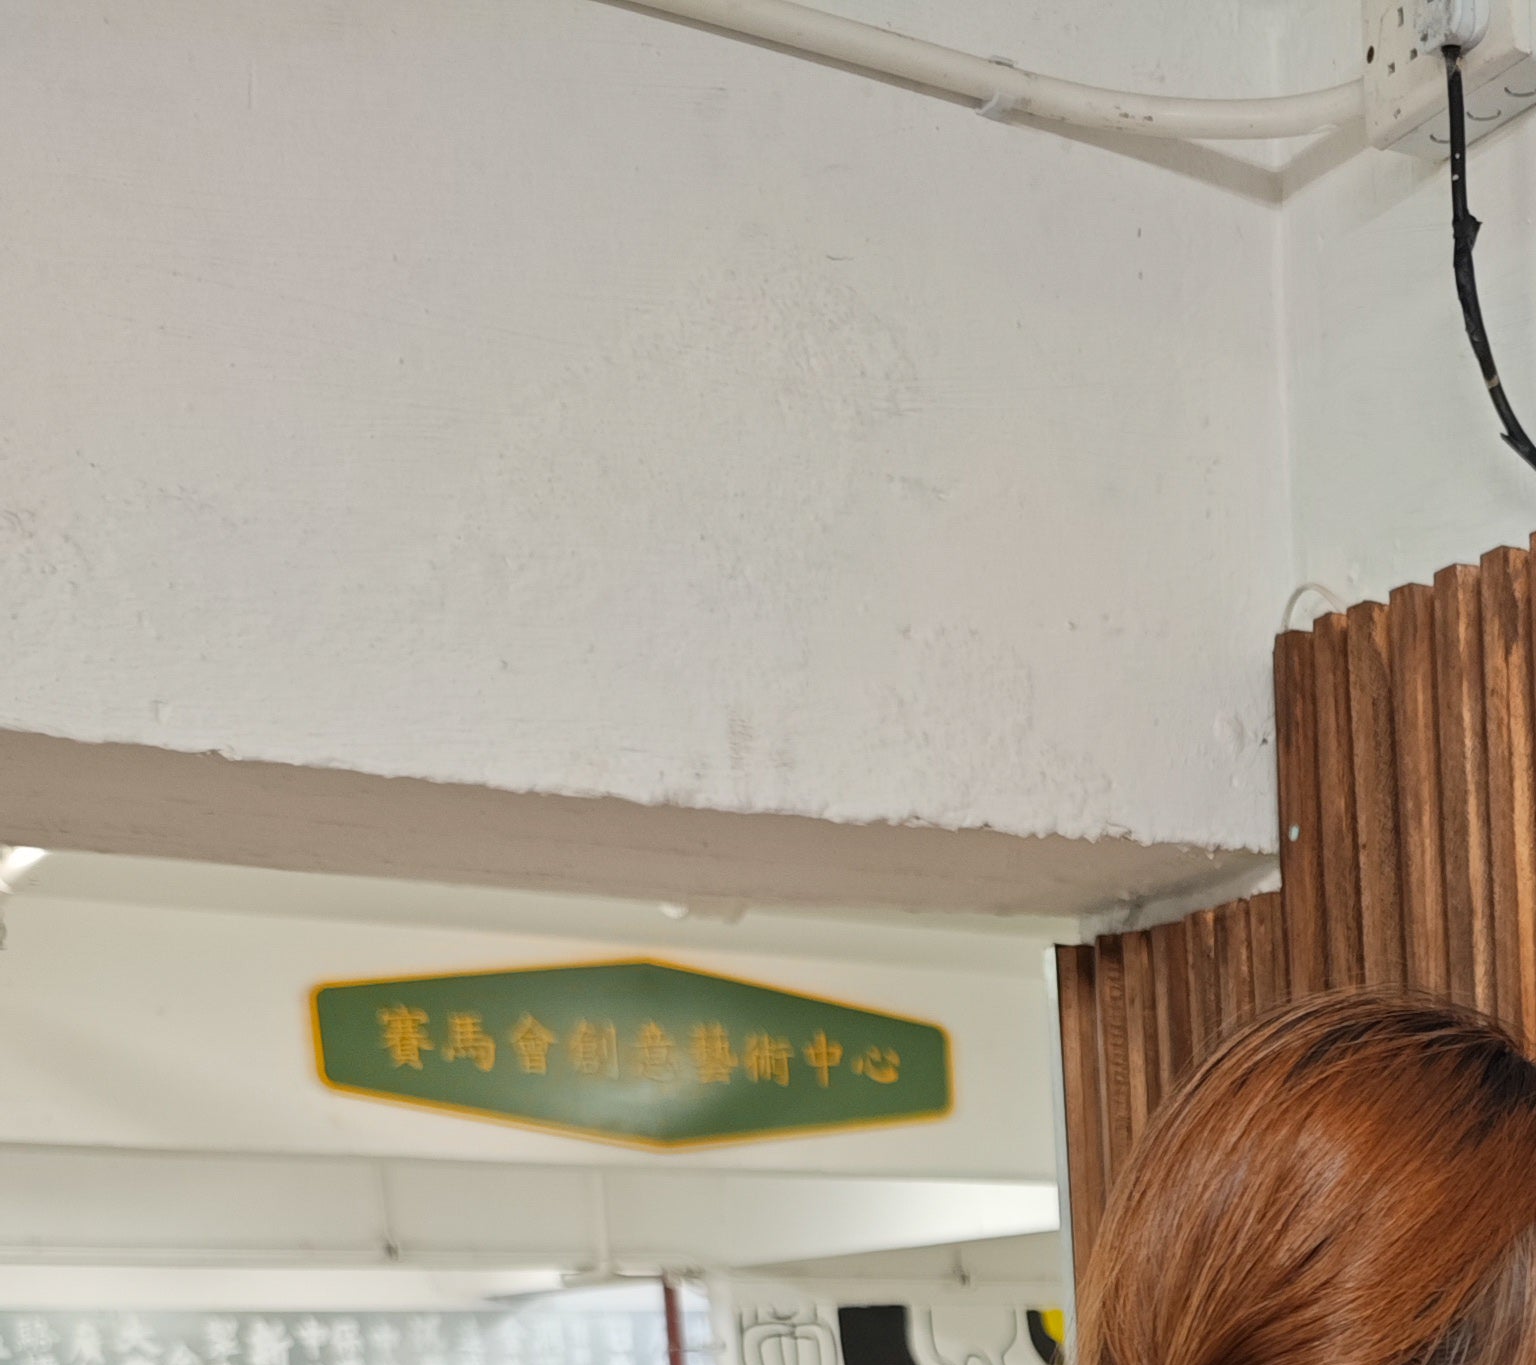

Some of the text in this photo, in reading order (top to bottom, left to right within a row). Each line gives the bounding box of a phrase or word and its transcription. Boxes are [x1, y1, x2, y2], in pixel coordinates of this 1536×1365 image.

[377, 1003, 900, 1088] 賽馬會創意藝術中心
